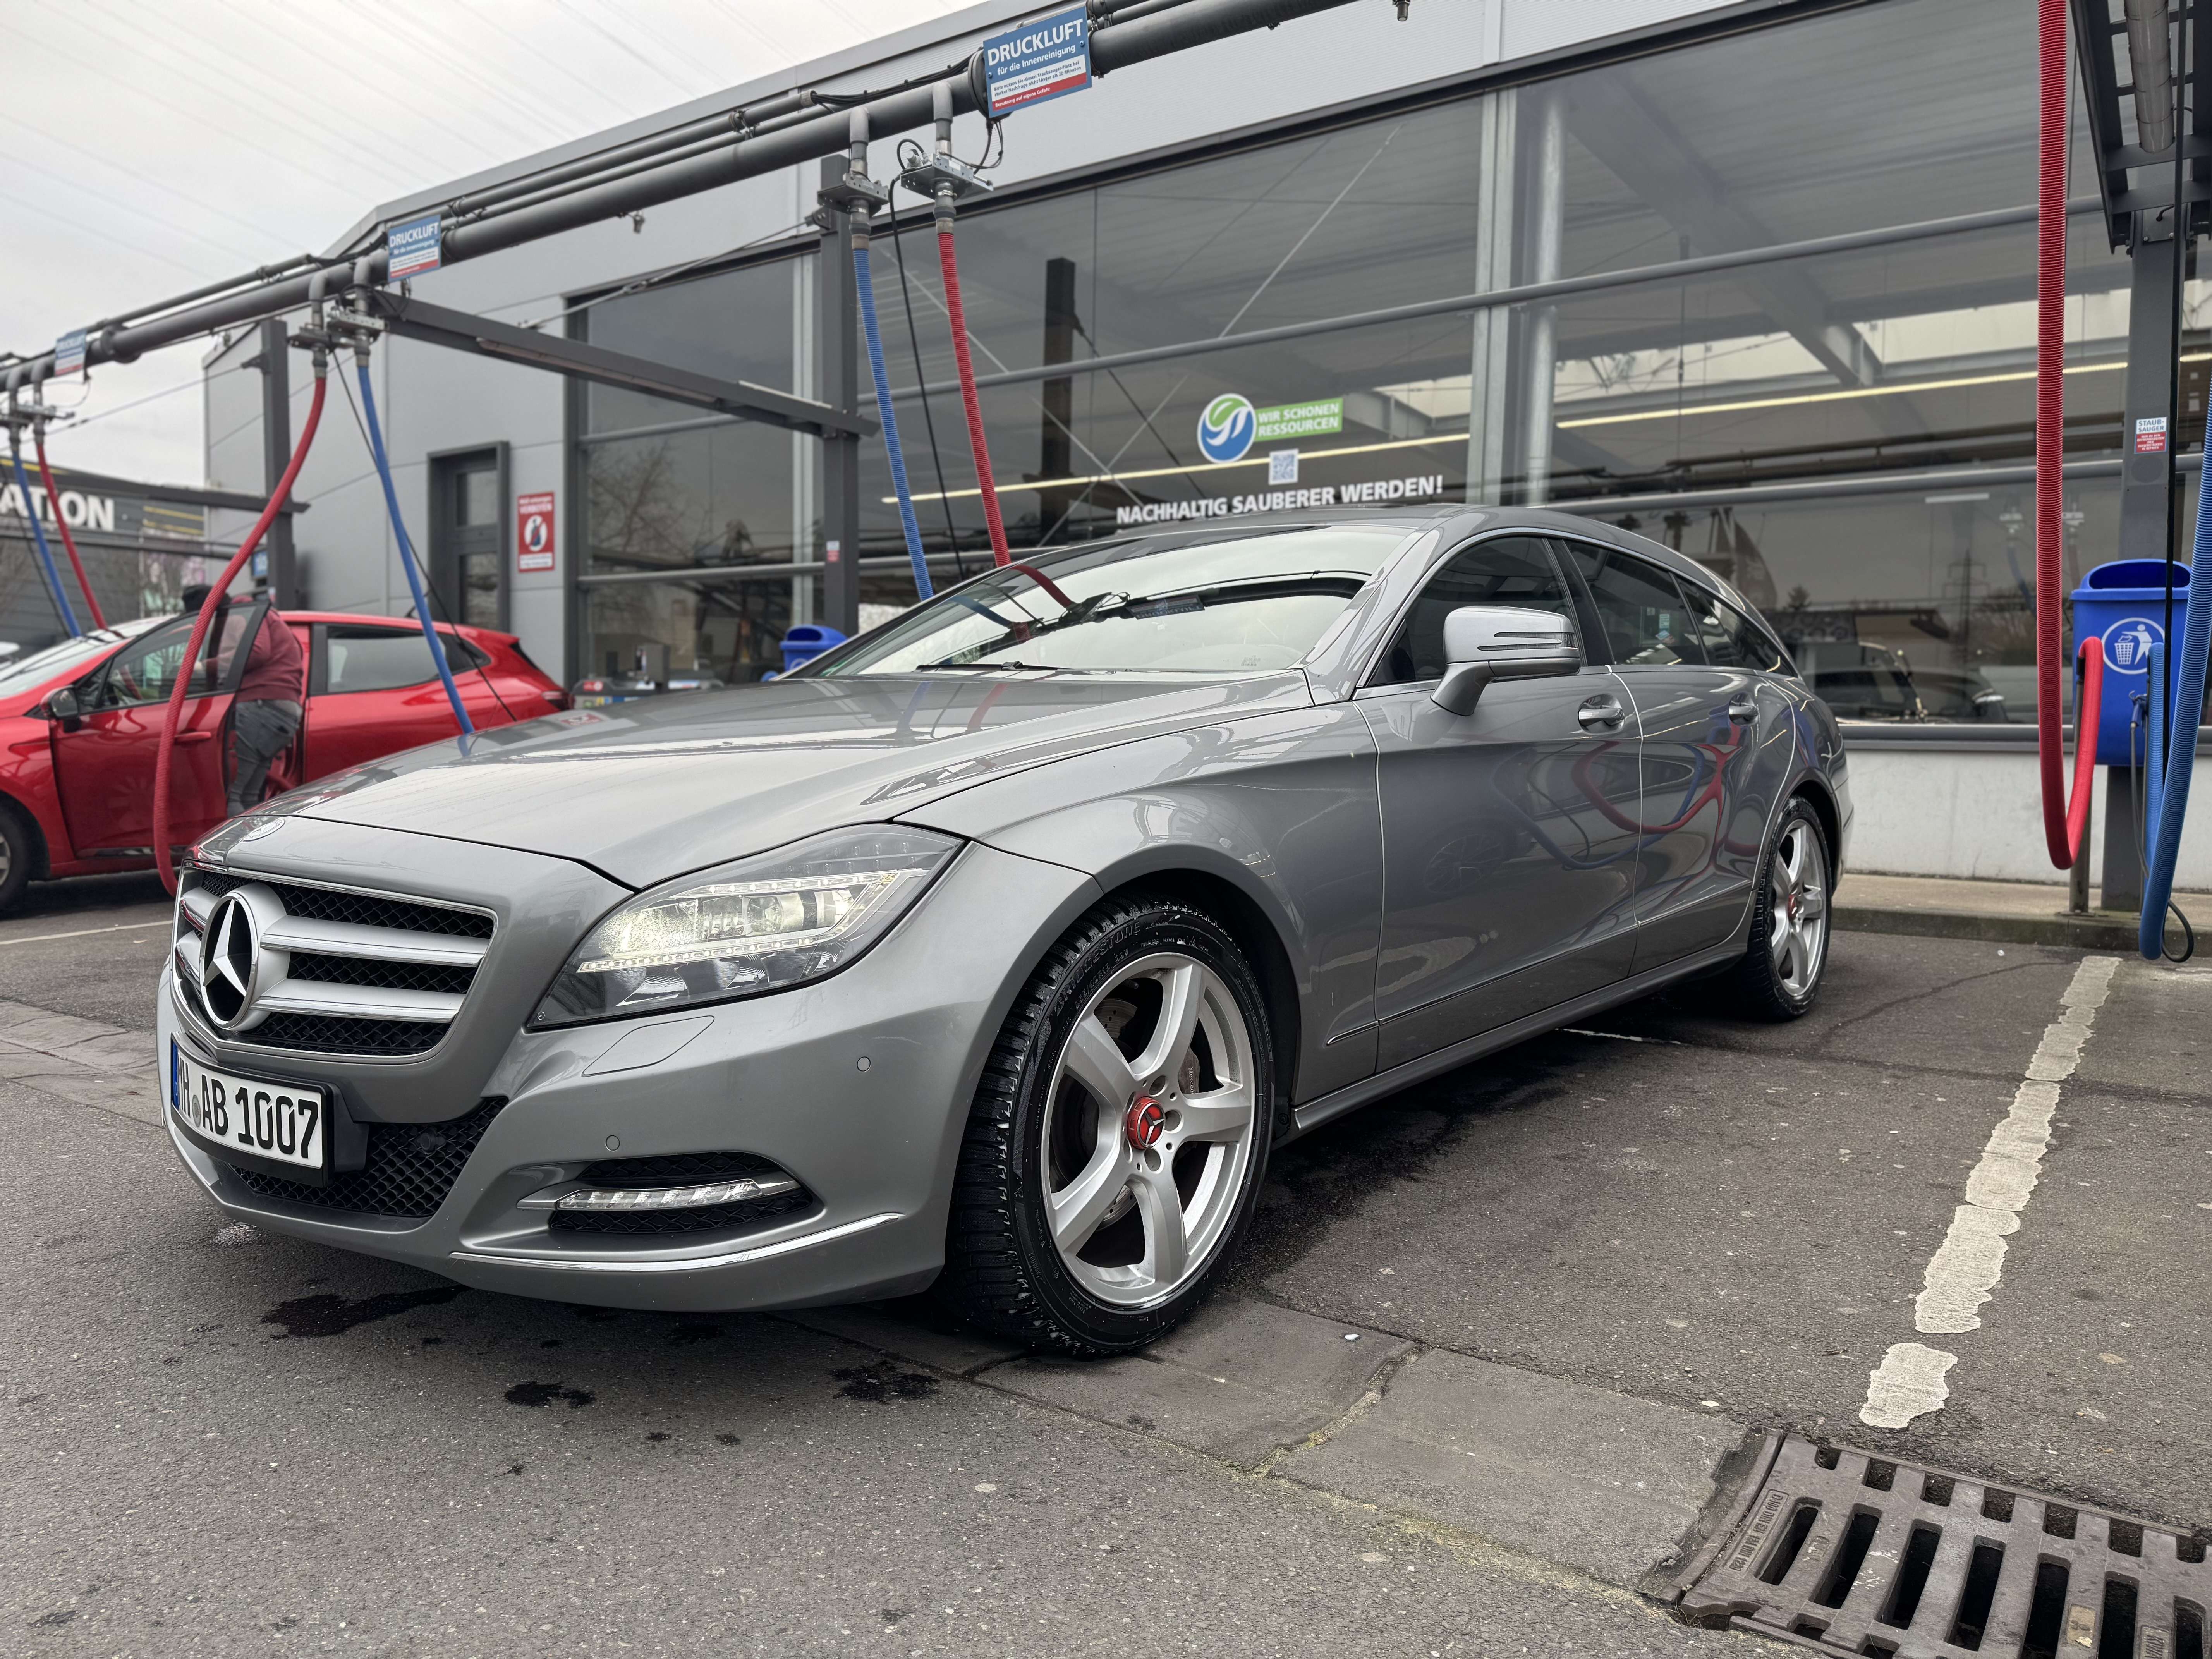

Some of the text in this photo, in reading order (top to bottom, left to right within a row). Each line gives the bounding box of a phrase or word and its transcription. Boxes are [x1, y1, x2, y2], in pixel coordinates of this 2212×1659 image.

[988, 19, 1083, 66] DRUCKLUFT
[997, 45, 1076, 76] für die Innenreinigung
[1008, 84, 1027, 93] Nachfrage
[1039, 76, 1052, 84] länger
[1065, 67, 1081, 75] Minuten
[1024, 74, 1037, 82] diesen
[1023, 91, 1036, 100] eigene
[390, 222, 439, 247] DRUCKLUFT
[1259, 403, 1339, 423] WIR SCHONEN
[1259, 417, 1339, 437] RESSOURCEN
[0, 483, 115, 532] ATION
[1116, 475, 1443, 524] NACHHALTIG SAUBERER WERDEN!
[202, 1074, 228, 1135] AB
[235, 1087, 318, 1158] 1007
[1752, 1522, 1768, 1534] EN
[1758, 1511, 1775, 1525] DIN
[1738, 1545, 1755, 1558] DIN
